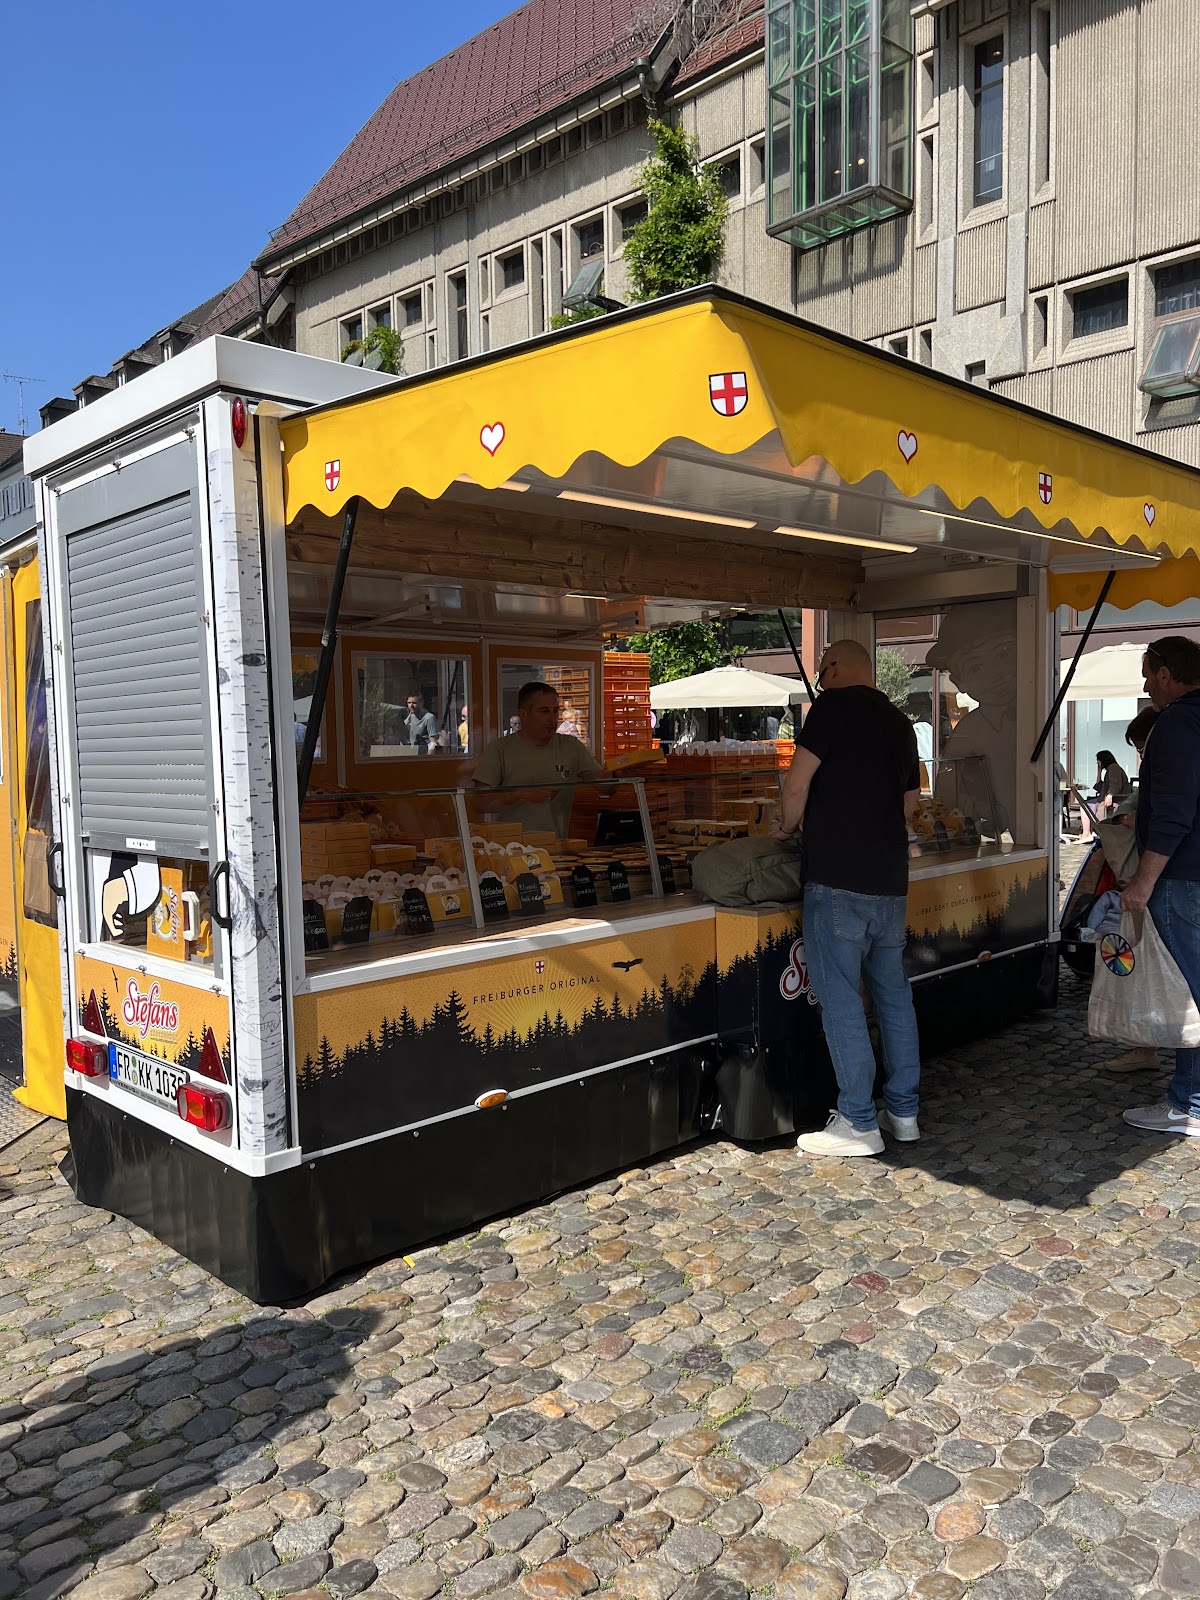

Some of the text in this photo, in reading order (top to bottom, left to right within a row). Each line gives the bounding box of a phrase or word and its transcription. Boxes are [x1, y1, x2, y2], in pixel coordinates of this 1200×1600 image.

[934, 901, 949, 912] GEHT
[951, 899, 969, 909] DURCH
[970, 894, 982, 903] DEN
[983, 890, 1001, 899] MAGEN
[473, 975, 601, 1005] FREIBURGER ORIGINAL
[123, 979, 178, 1038] Stefans
[117, 1051, 131, 1081] FR
[138, 1060, 153, 1091] KK
